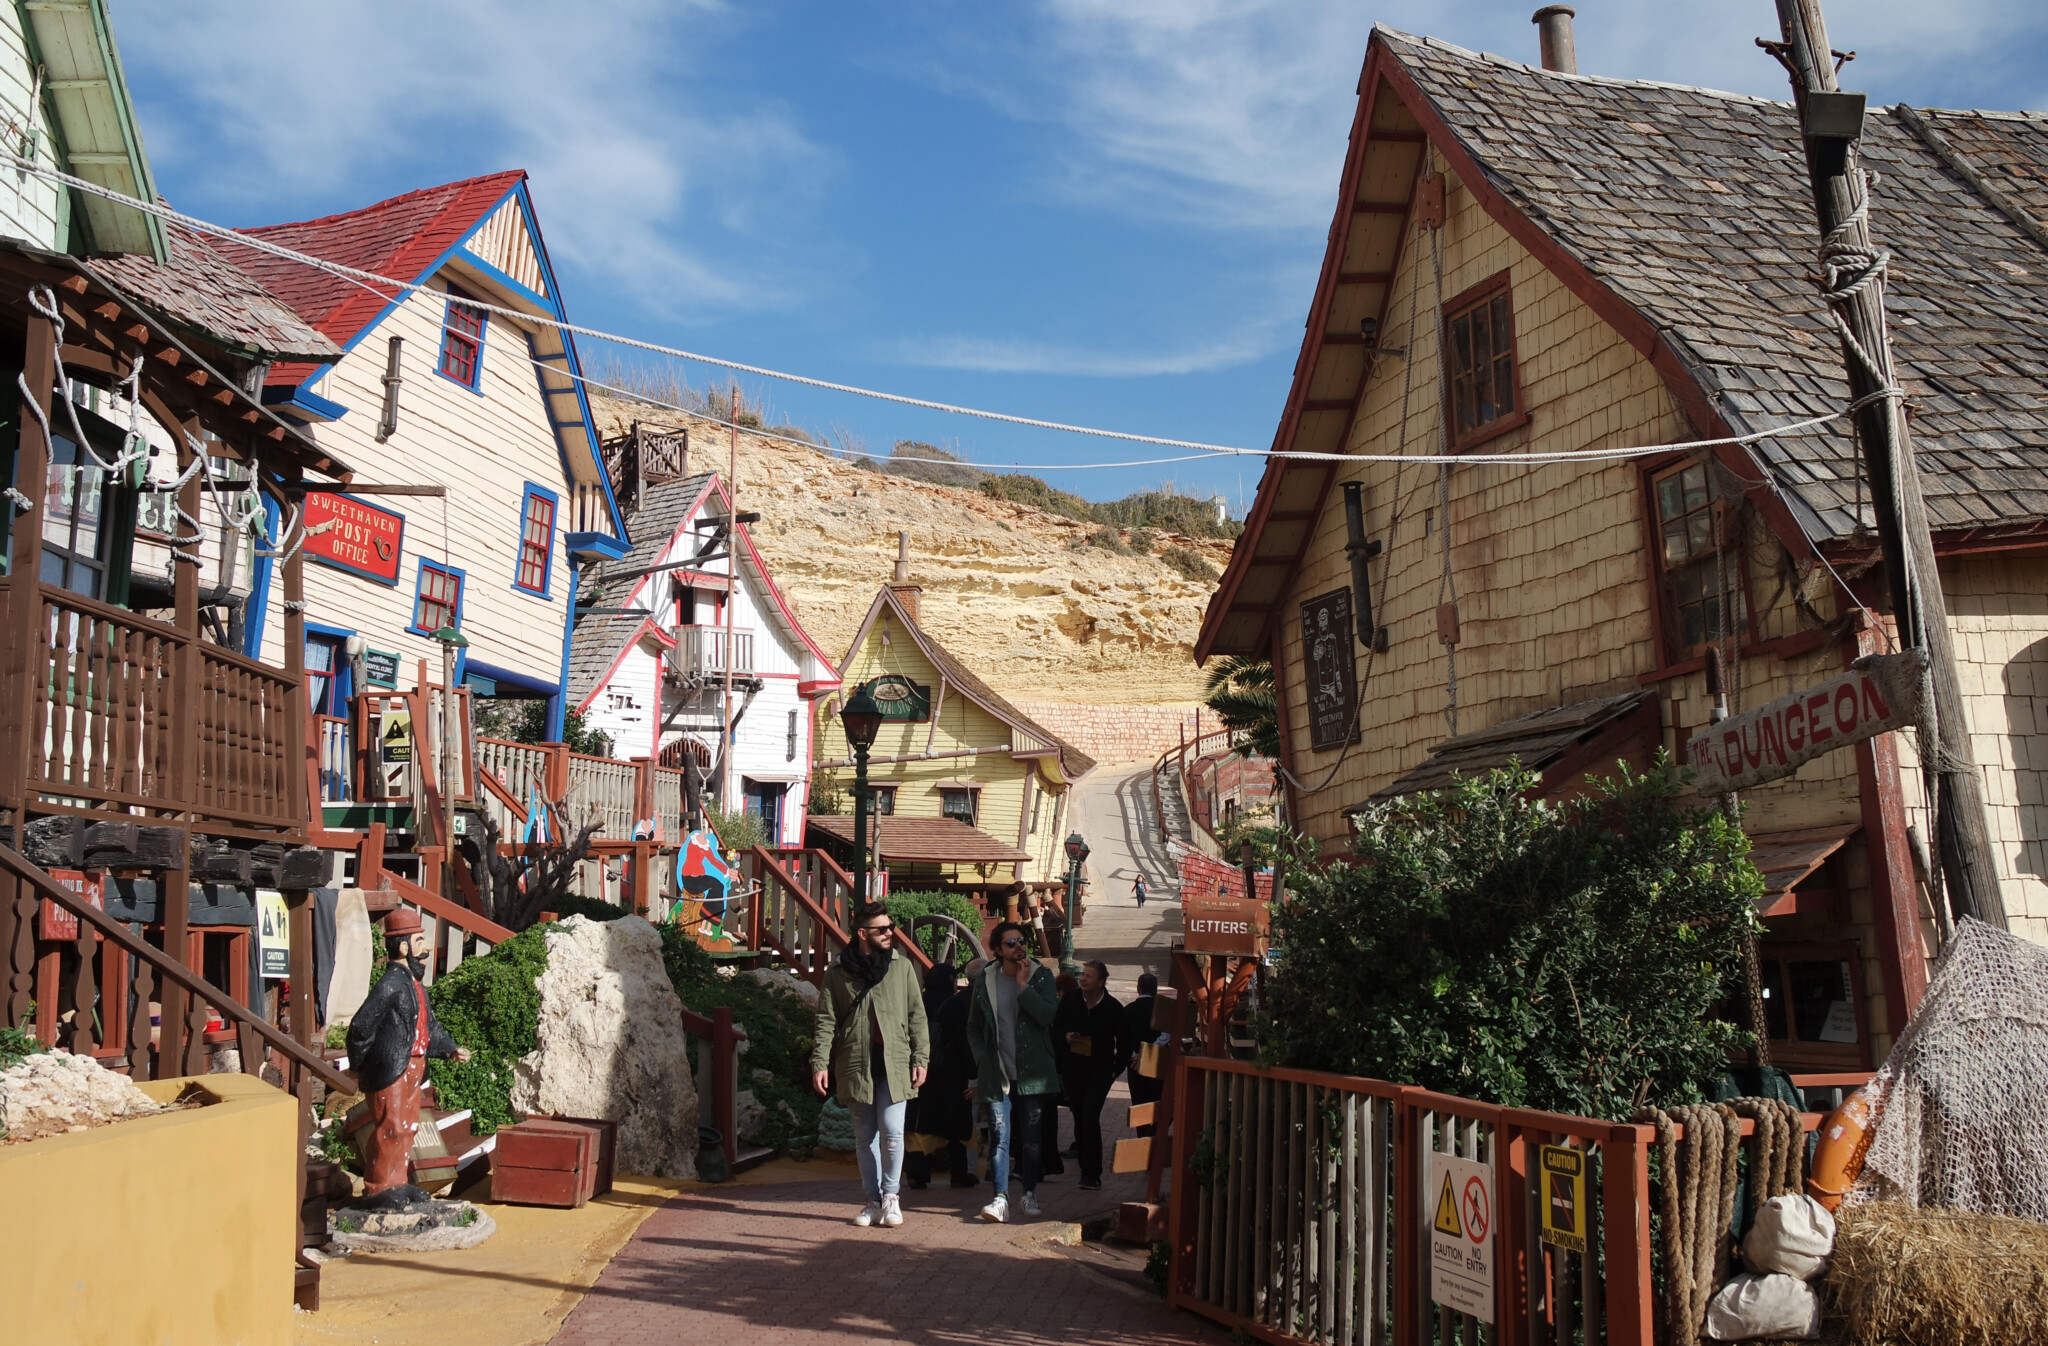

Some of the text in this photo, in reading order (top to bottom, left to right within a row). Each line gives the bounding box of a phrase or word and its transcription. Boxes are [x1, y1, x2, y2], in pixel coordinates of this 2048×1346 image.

[312, 494, 395, 534] SWEETHAVEN
[335, 518, 371, 546] POST
[332, 539, 369, 565] OFFICE
[1693, 676, 1891, 778] THE DUNGEON
[1191, 919, 1248, 934] LETTERS
[267, 951, 285, 961] CAUTION
[1547, 1151, 1577, 1171] CAUTION
[1543, 1228, 1585, 1252] NO SMOKING
[1434, 1241, 1463, 1261] CAUTION
[1471, 1246, 1482, 1260] NO
[1466, 1258, 1488, 1276] ENTRY
